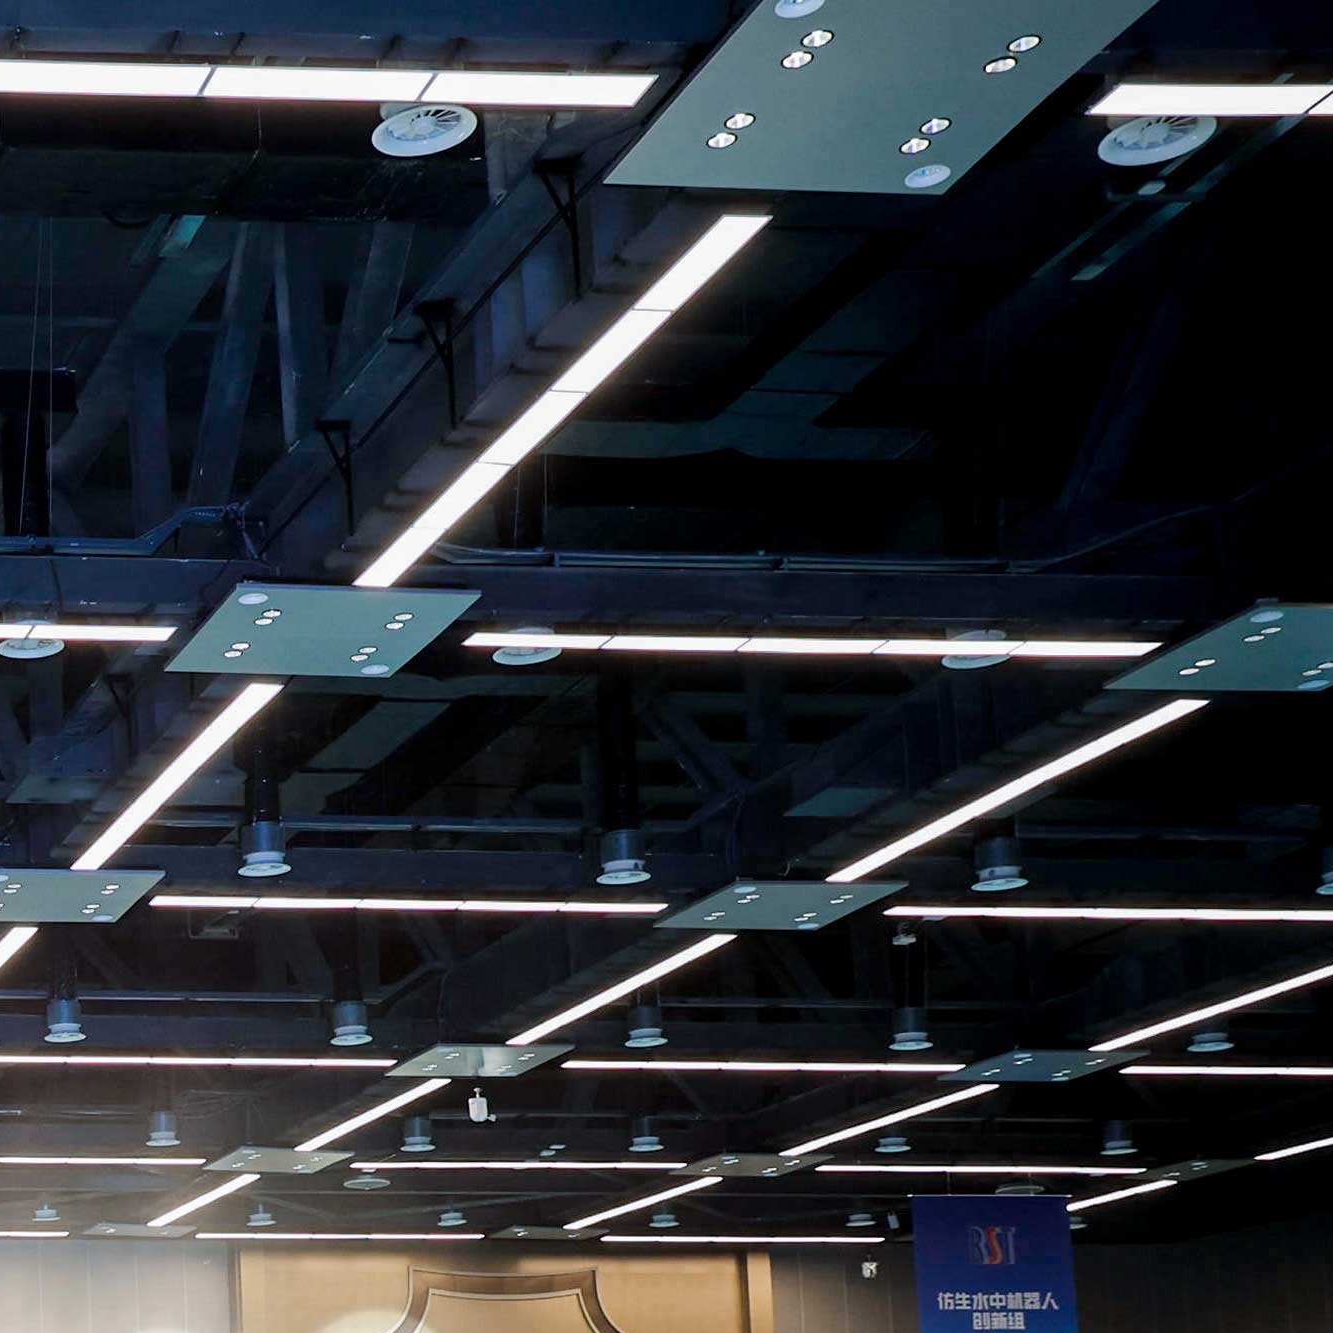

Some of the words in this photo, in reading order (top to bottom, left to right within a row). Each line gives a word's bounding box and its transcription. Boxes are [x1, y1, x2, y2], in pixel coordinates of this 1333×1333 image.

[967, 1226, 1016, 1265] RST
[937, 1292, 1059, 1311] 仿生水中机器人
[972, 1311, 1026, 1331] 创新组
